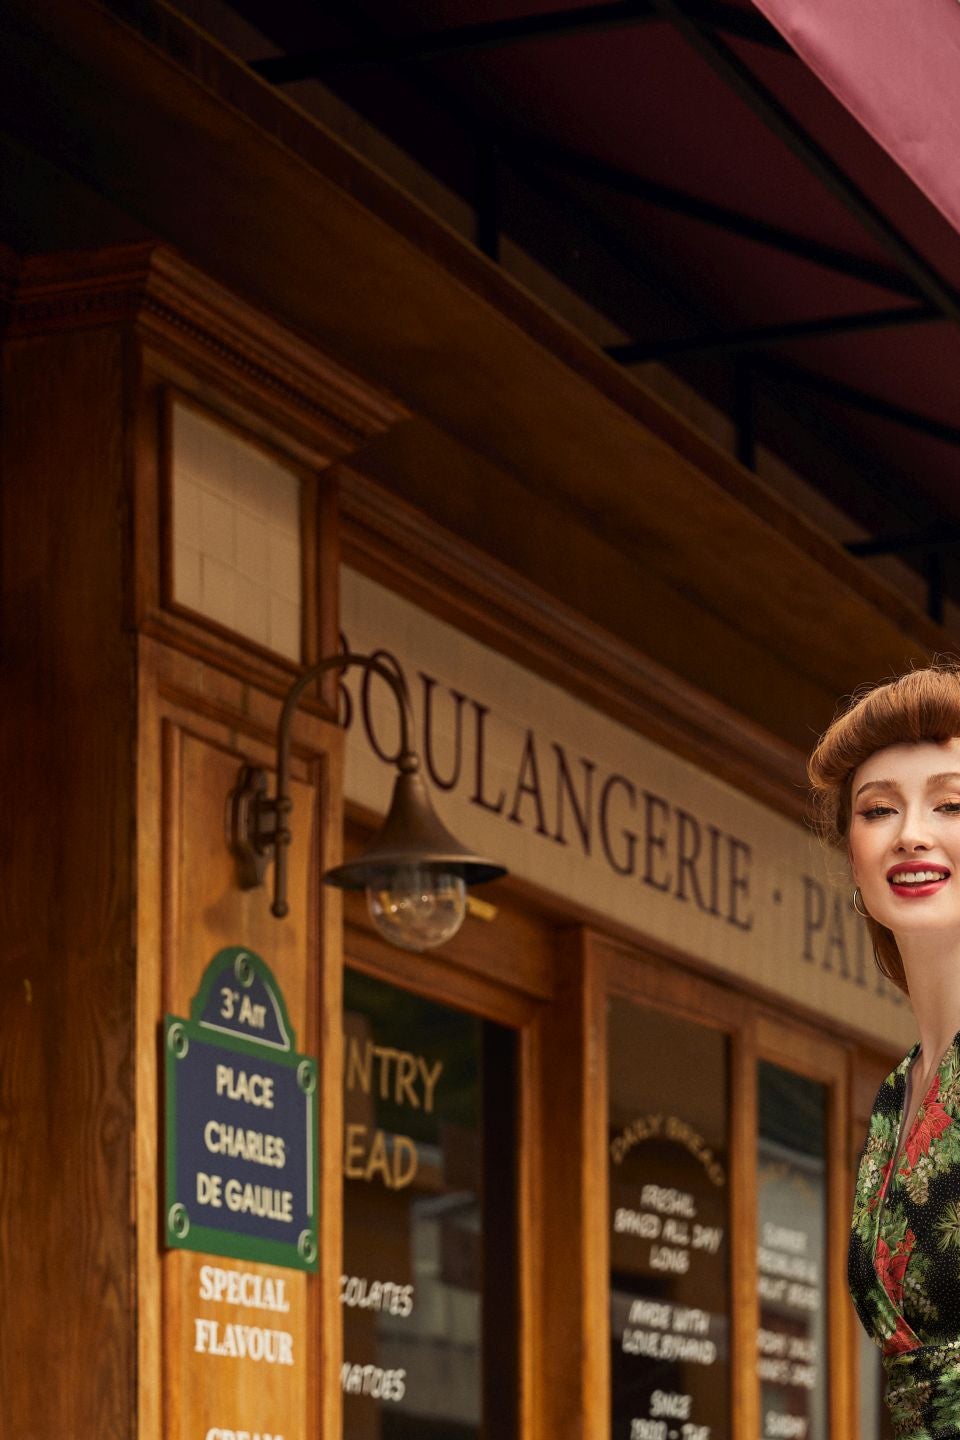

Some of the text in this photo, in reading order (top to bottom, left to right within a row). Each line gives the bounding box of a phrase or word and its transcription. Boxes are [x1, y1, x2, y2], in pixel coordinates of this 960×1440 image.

[215, 1064, 274, 1109] PLACE
[343, 1036, 443, 1113] NTRY
[204, 1120, 286, 1169] CHARLES
[344, 1122, 418, 1191] EAD
[196, 1172, 293, 1222] DE GAULLE
[199, 1265, 290, 1312] SPECIAL
[195, 1318, 294, 1366] FLAVOUR
